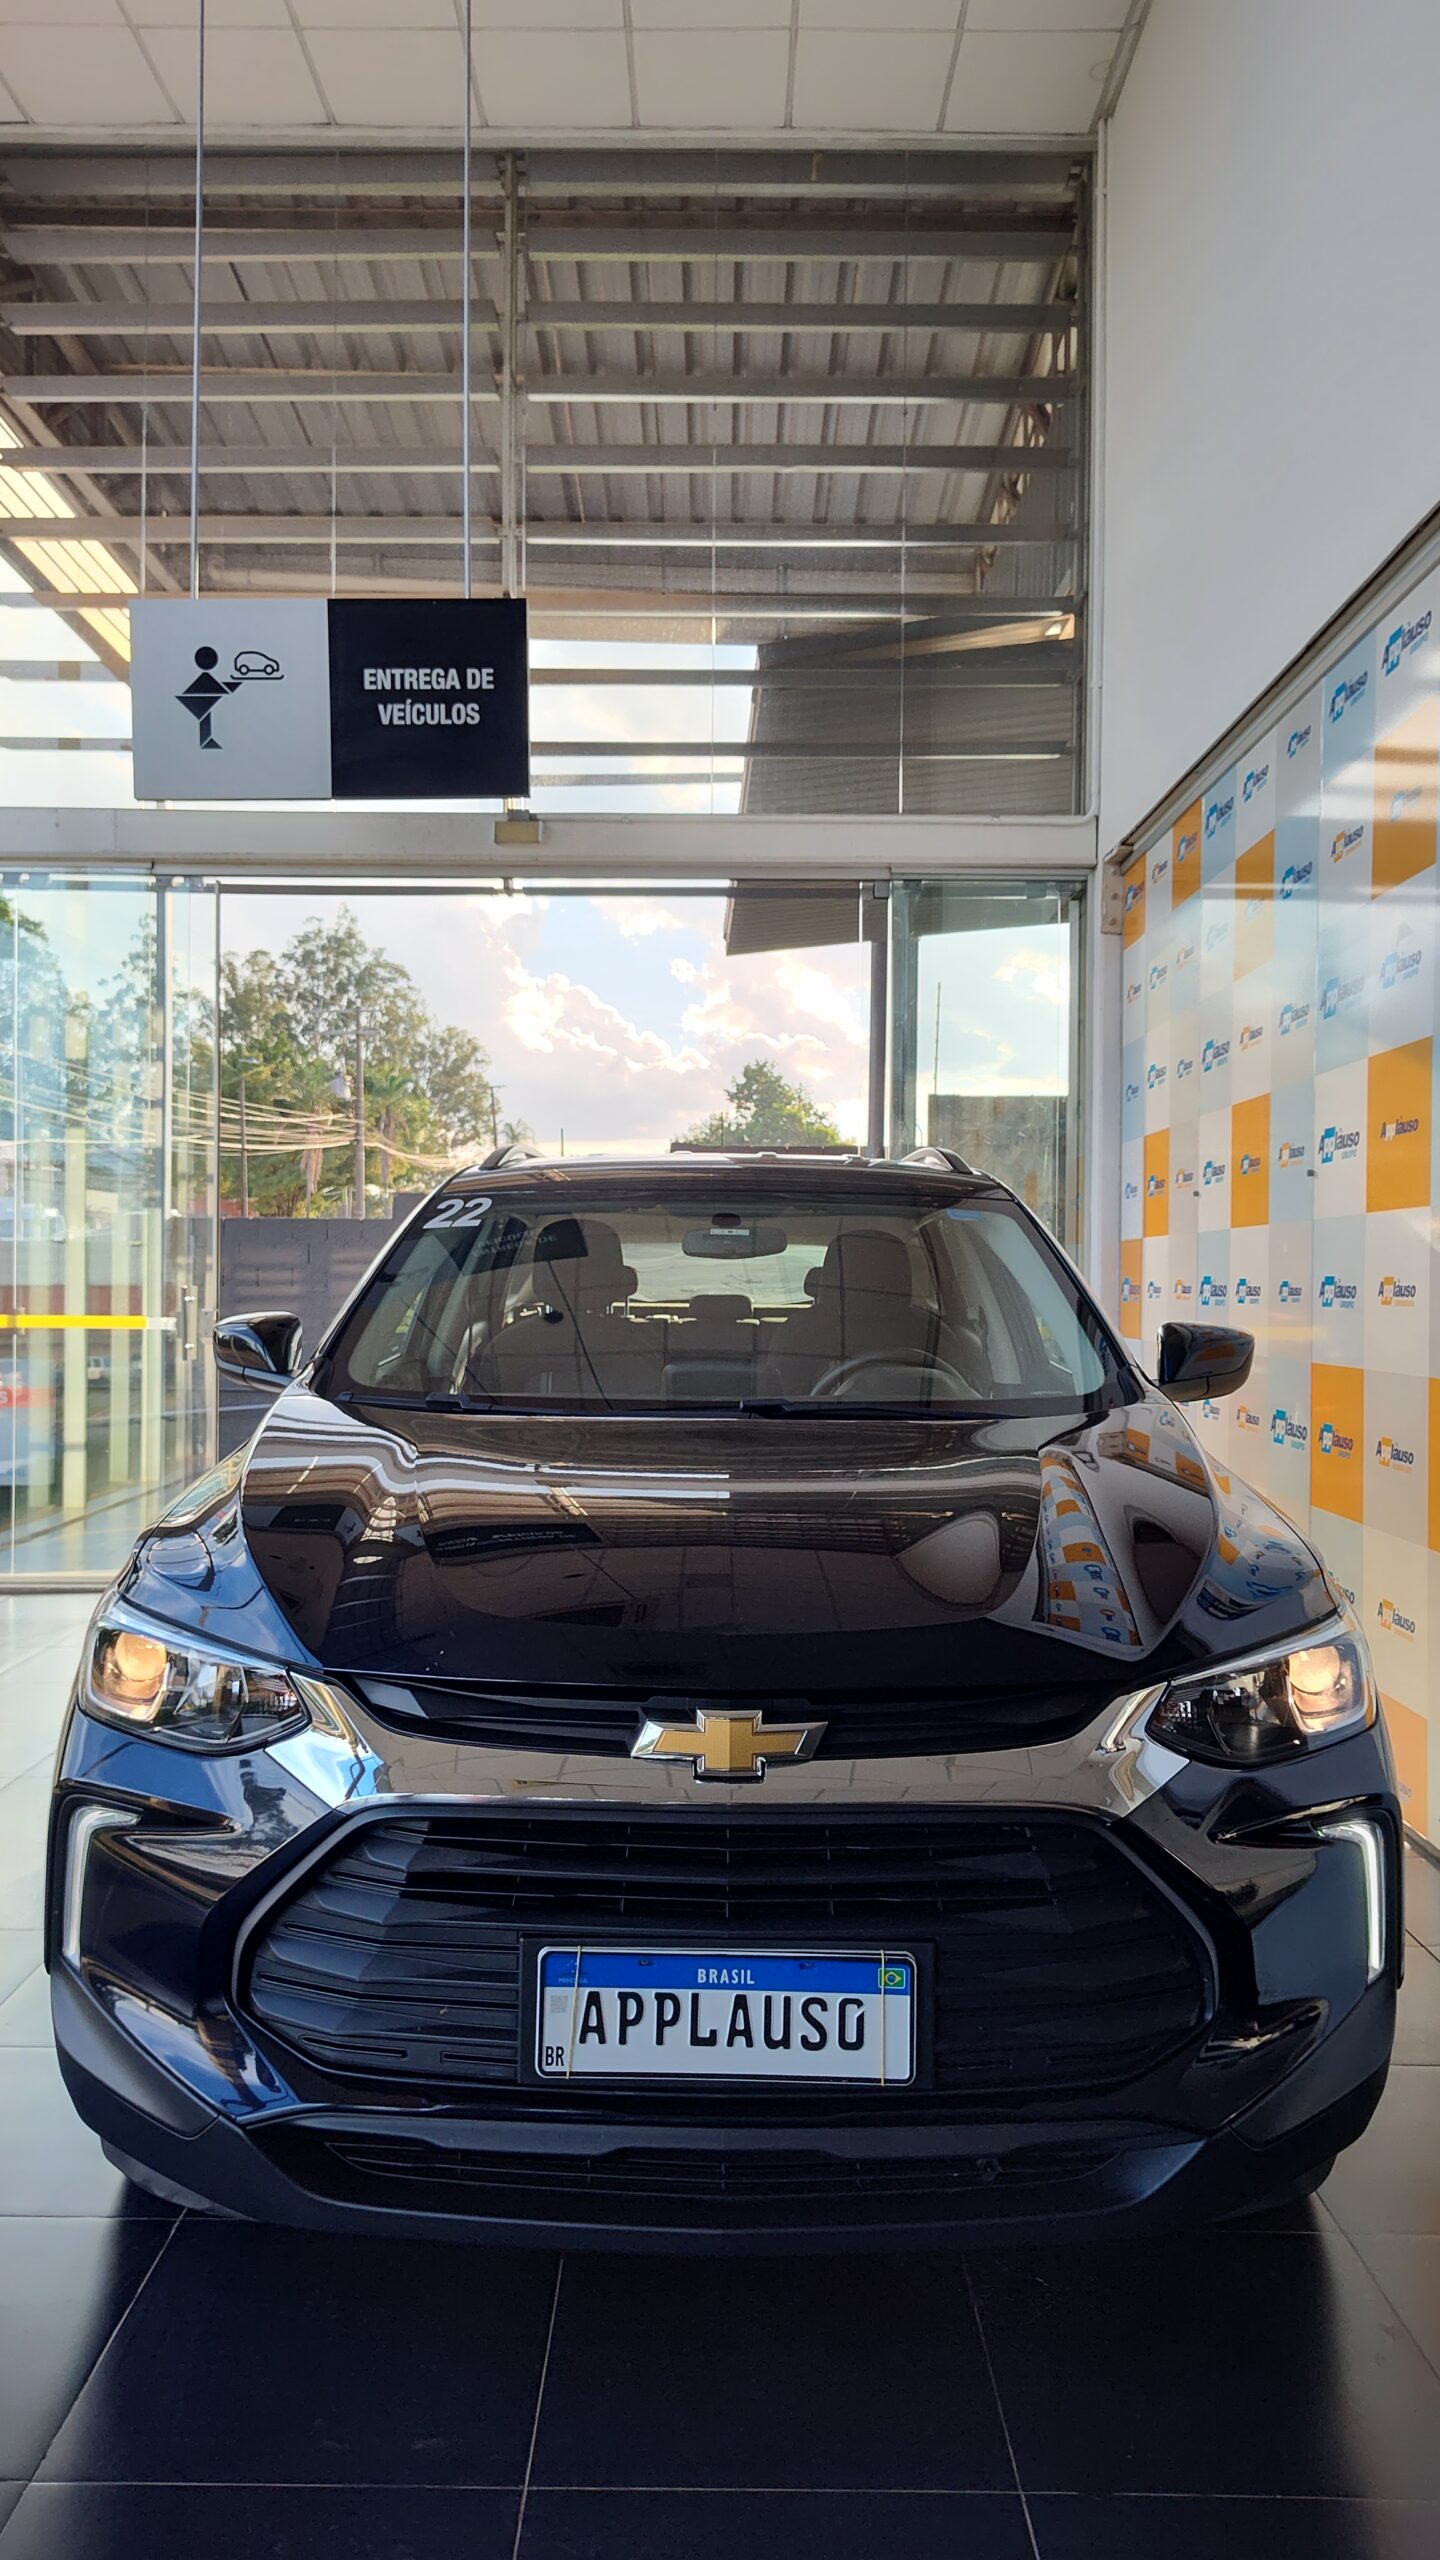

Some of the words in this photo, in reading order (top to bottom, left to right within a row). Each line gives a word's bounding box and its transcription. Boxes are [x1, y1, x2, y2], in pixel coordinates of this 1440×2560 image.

[363, 668, 461, 691] ENTREGA
[466, 668, 495, 691] DE
[378, 698, 481, 726] VEÍCULOS
[422, 1197, 494, 1229] 22
[697, 1968, 755, 1985] BRASIL
[578, 1990, 866, 2051] APPLAUSO
[545, 2046, 565, 2067] BR
